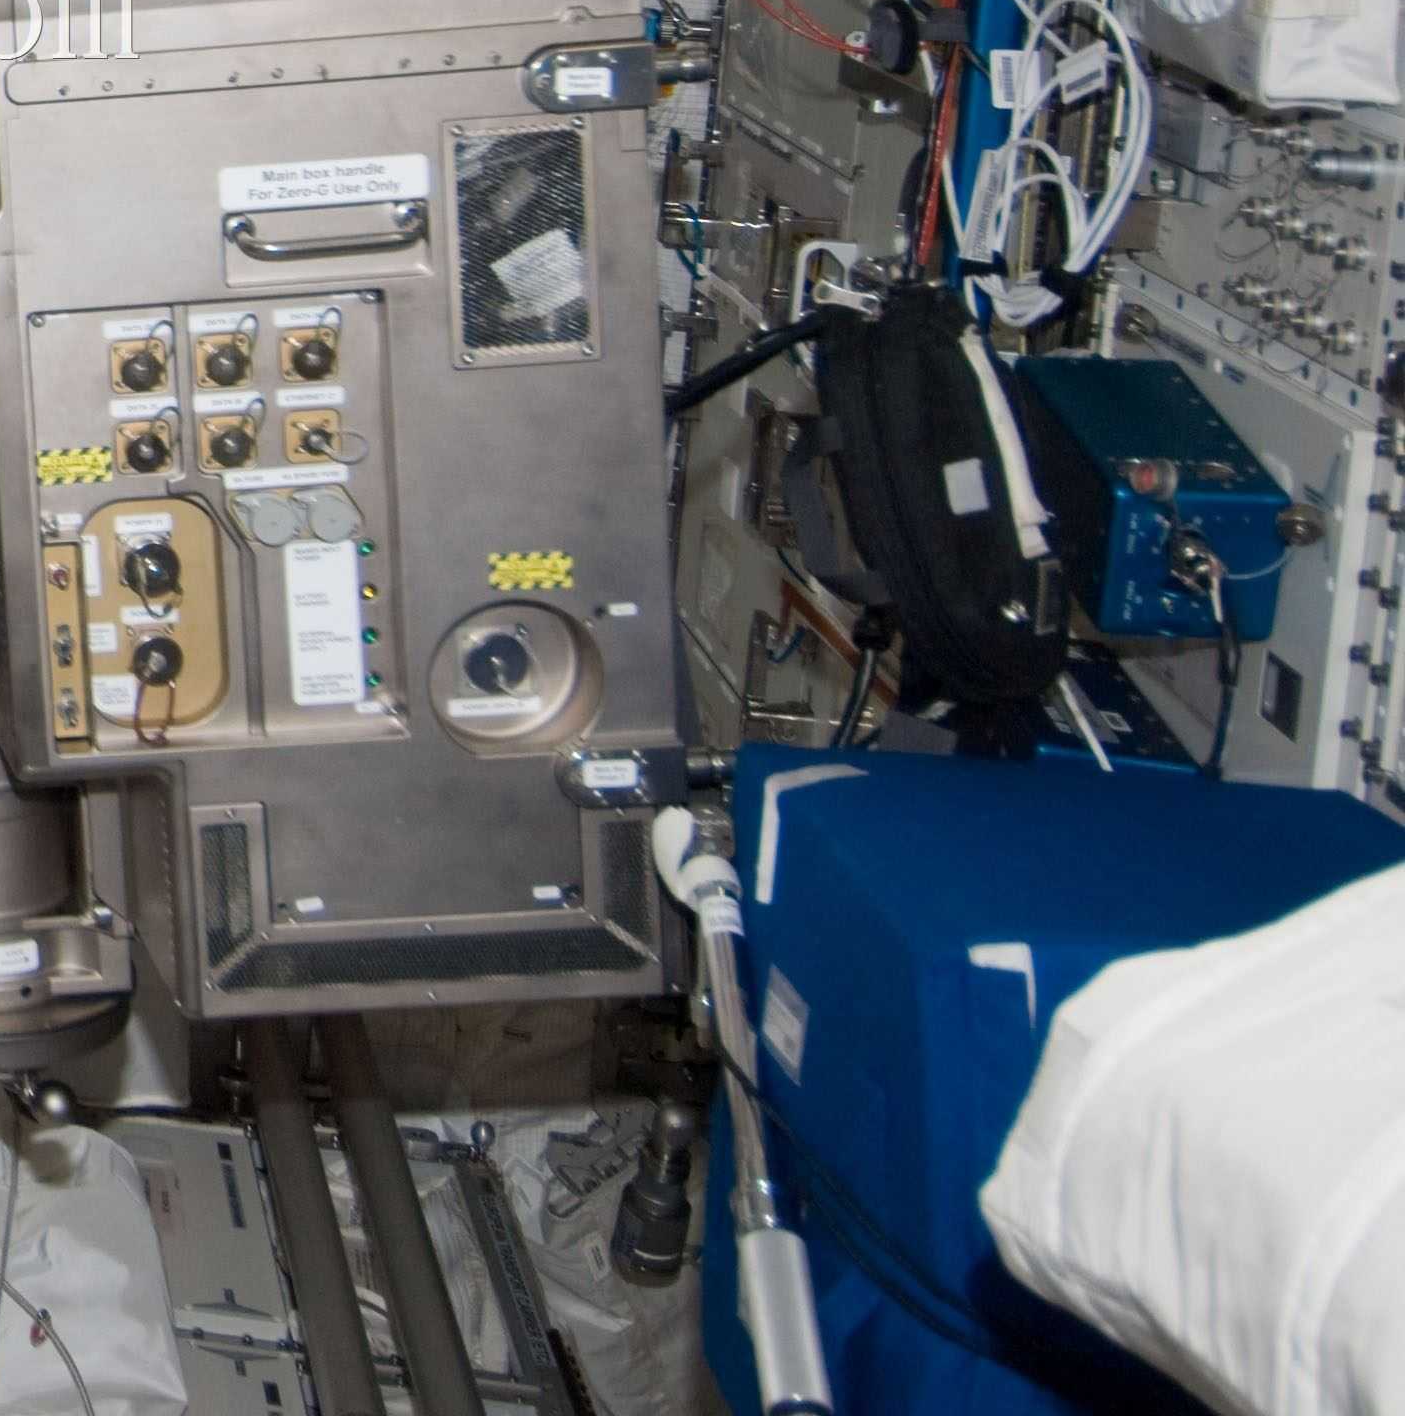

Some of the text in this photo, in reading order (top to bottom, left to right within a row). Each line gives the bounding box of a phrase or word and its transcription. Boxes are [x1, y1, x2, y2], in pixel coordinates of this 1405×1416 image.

[262, 163, 386, 183] Main box handle
[247, 178, 402, 201] For Zero-G Use Only
